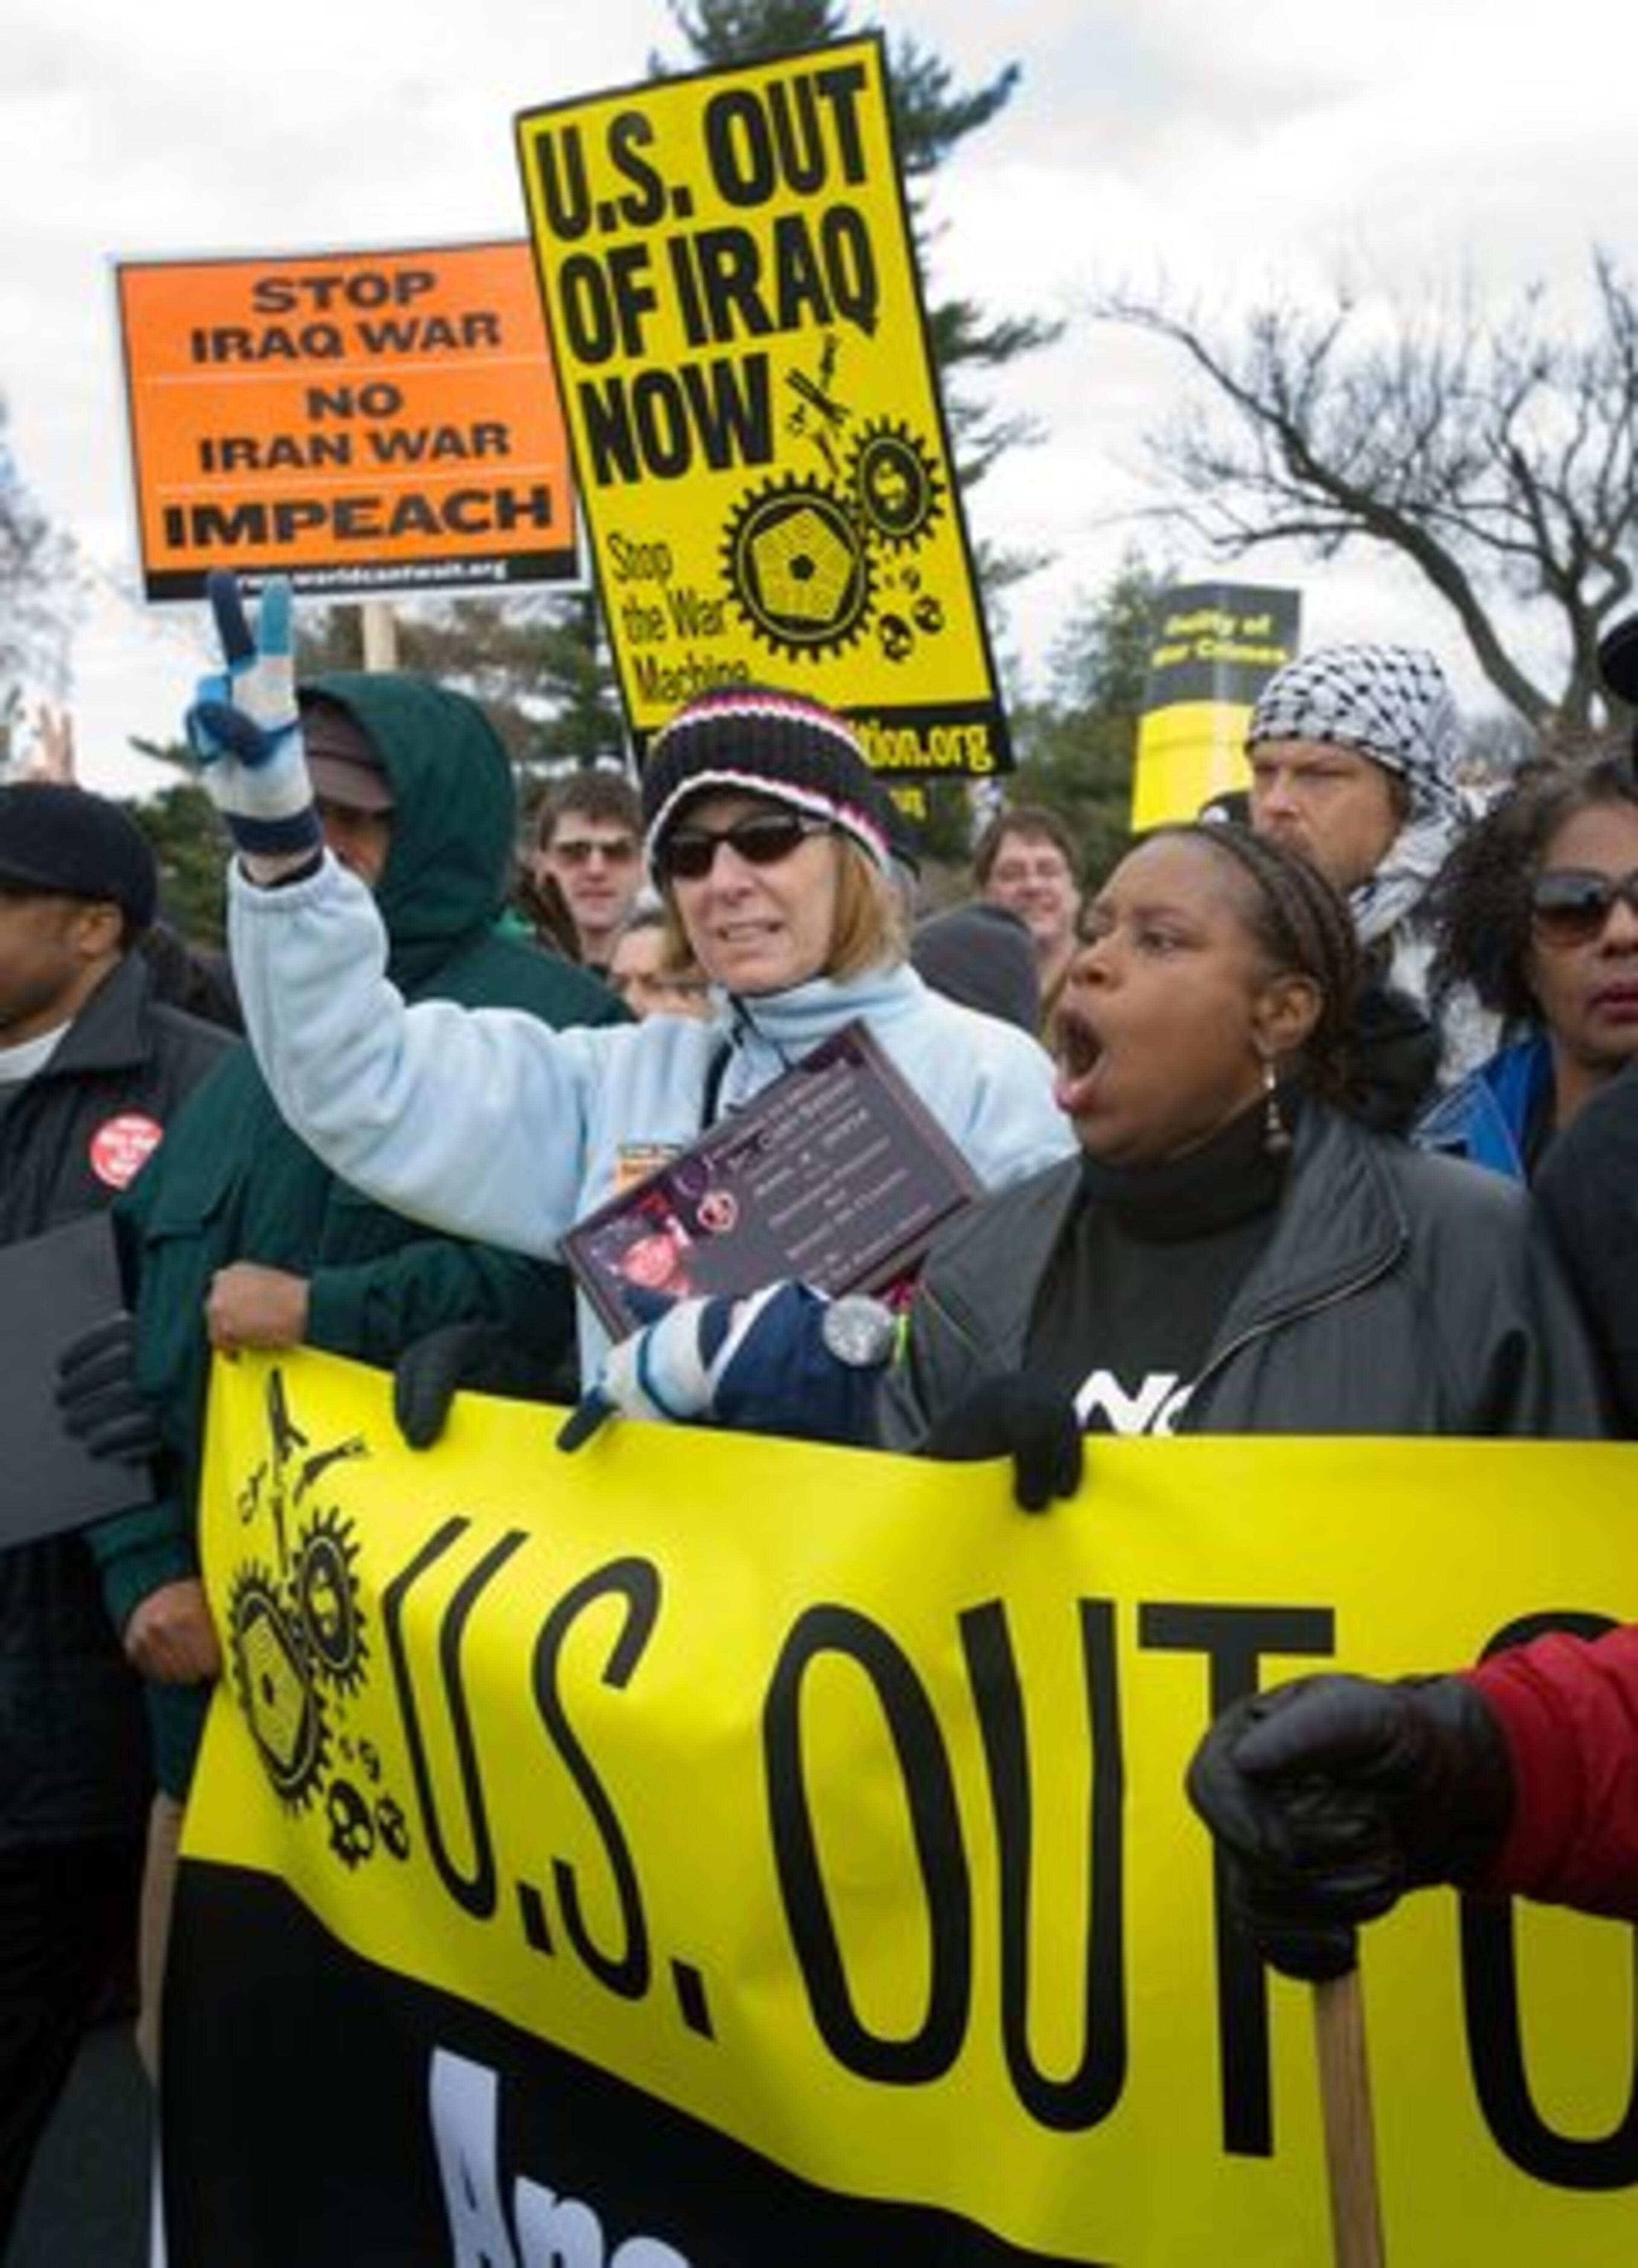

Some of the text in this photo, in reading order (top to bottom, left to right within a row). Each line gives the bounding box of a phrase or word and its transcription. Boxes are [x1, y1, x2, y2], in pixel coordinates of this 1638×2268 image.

[534, 62, 868, 241] U.S. OUT
[252, 271, 437, 314] STOP
[559, 205, 880, 365] OF IRAQ
[191, 313, 502, 363] IRAQ WAR
[306, 383, 404, 421] NO
[578, 352, 774, 489] NOW
[200, 424, 510, 473] IRAN WAR
[162, 485, 553, 549] IMPEACH
[607, 531, 674, 587] Stop
[622, 587, 727, 645] the War
[381, 1515, 717, 2042] U.S.
[764, 1597, 1335, 2158] OUT
